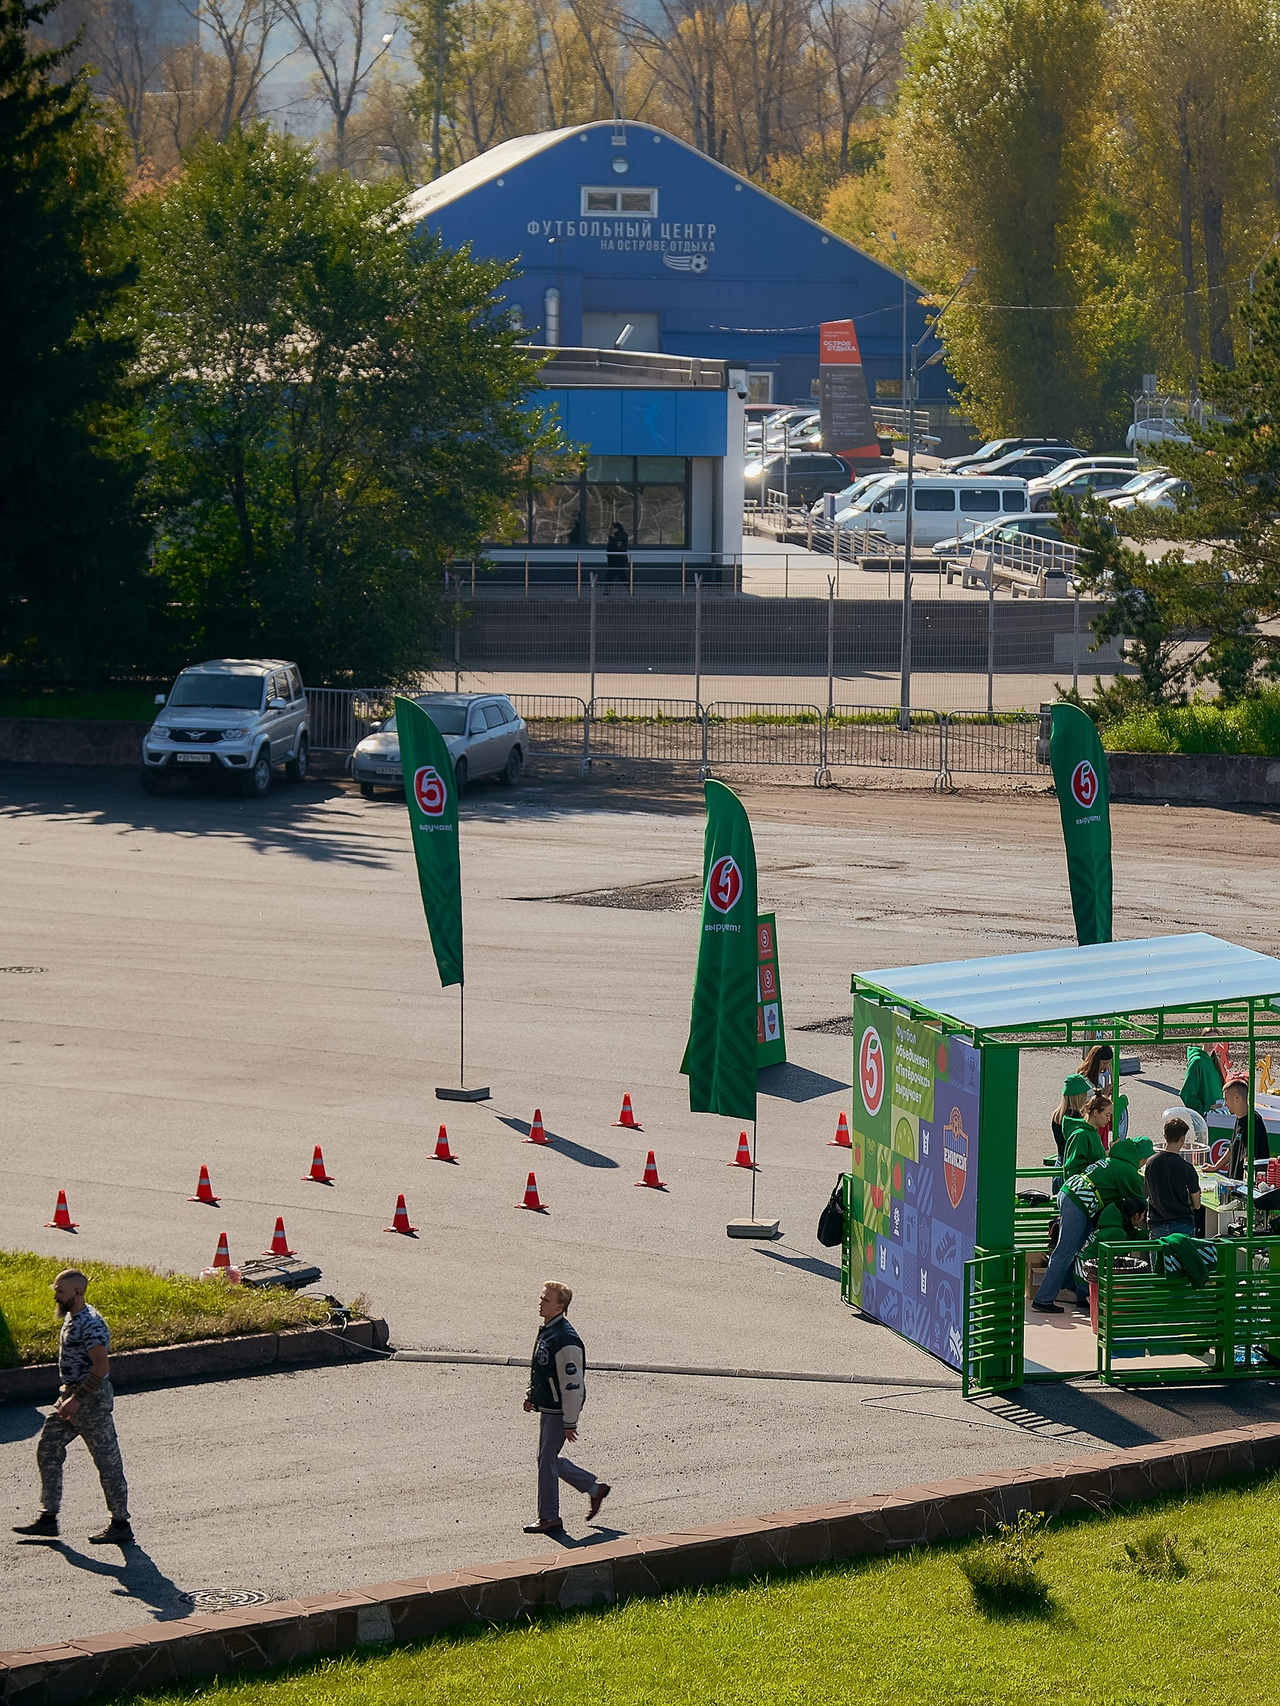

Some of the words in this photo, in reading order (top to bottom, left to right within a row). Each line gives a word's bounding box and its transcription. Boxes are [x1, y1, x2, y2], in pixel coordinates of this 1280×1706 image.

[526, 219, 652, 238] ФУТБОЛЬНЫЙ
[660, 222, 717, 241] ЦЕНТР
[600, 239, 615, 251] НА
[617, 239, 667, 252] ОСТРОВЕ
[669, 240, 716, 253] ОТДЫХА
[895, 1024, 917, 1045] Футбол
[895, 1044, 930, 1069] объединяет!
[895, 1082, 923, 1104] выручает
[943, 1147, 967, 1172] ЕНИСЕЙ
